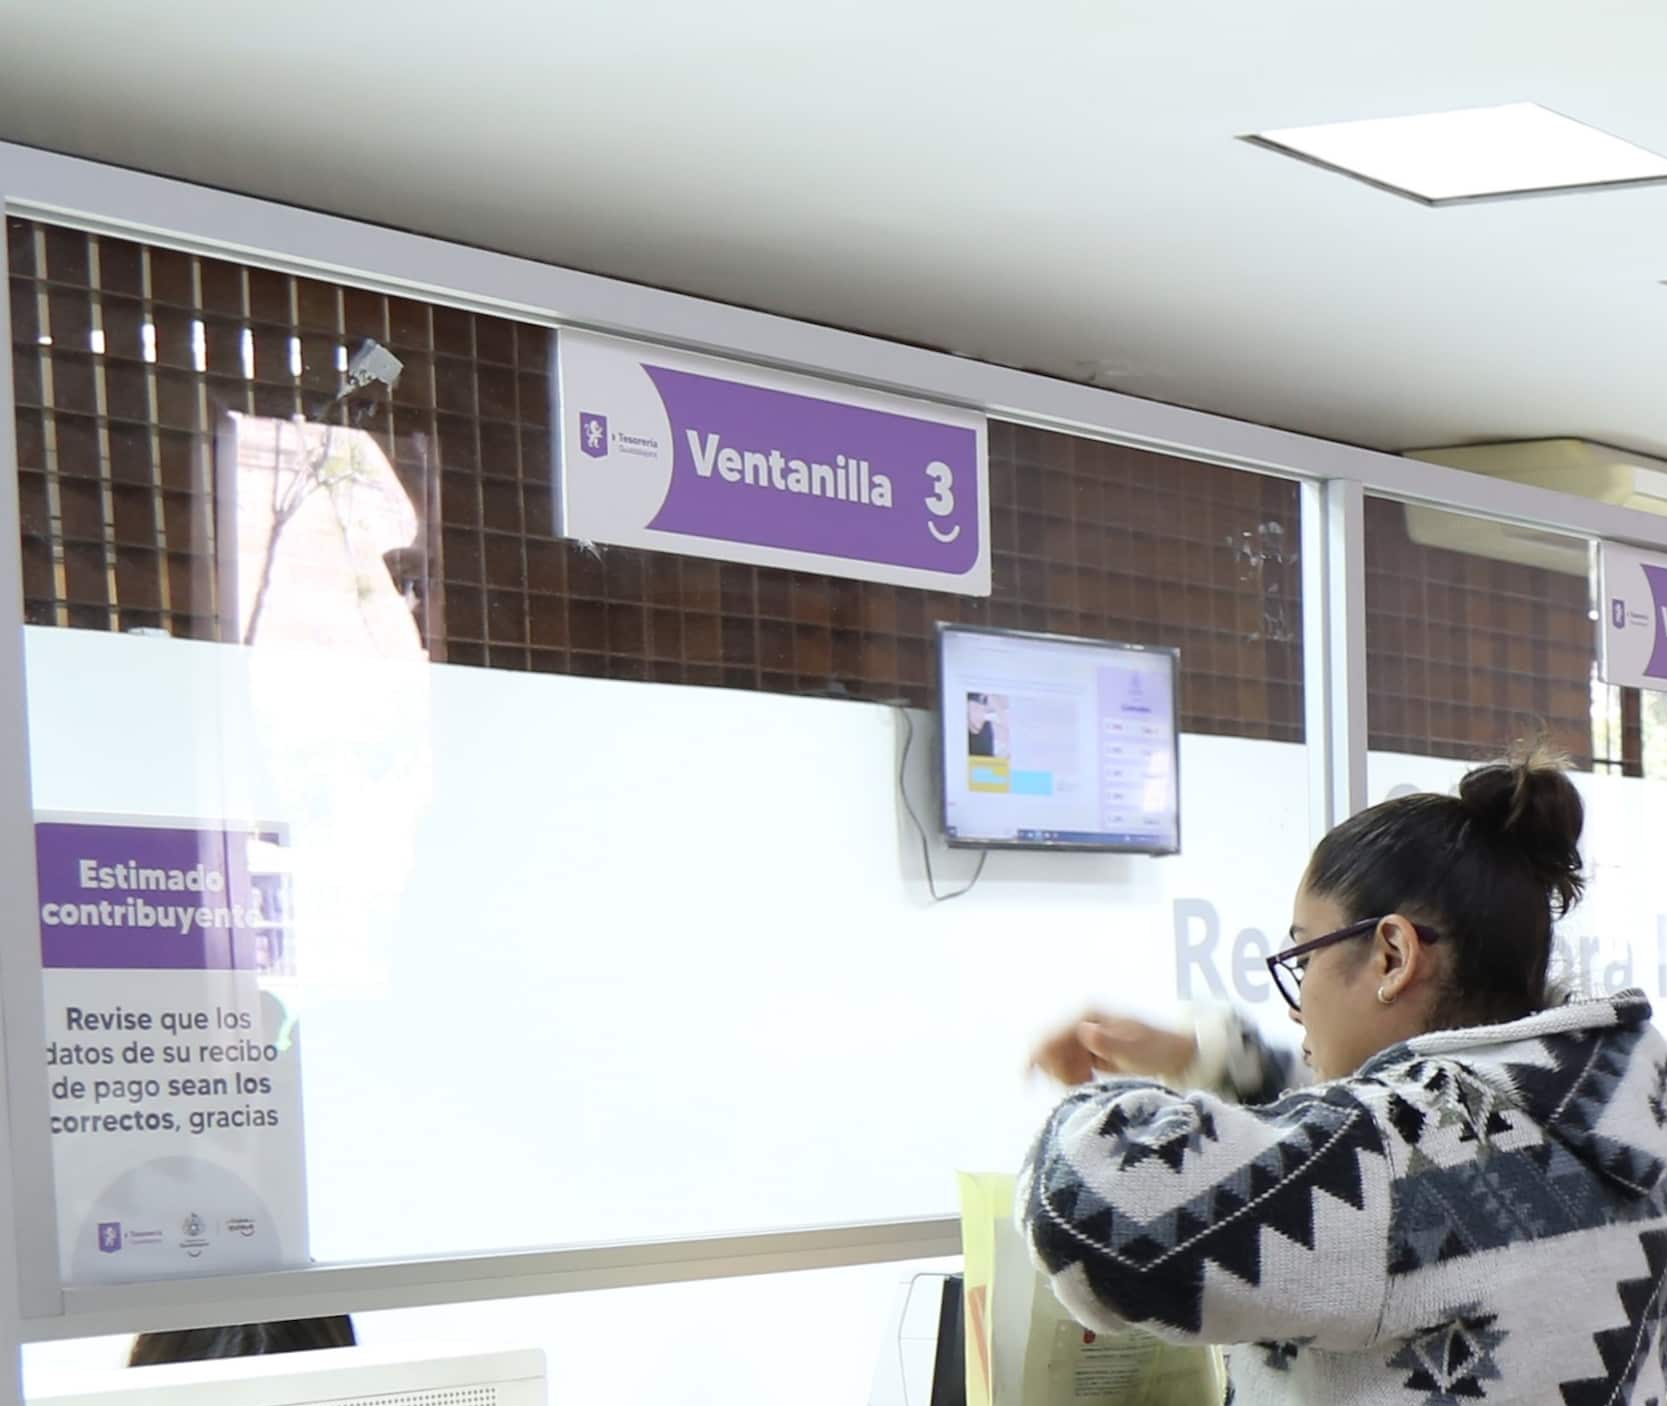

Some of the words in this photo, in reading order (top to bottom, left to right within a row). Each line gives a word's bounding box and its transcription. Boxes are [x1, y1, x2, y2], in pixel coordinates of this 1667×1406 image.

[686, 429, 893, 508] Ventanilla
[924, 460, 955, 517] 3
[79, 859, 225, 893] Estimado
[66, 1007, 152, 1031] Revise
[160, 1012, 209, 1035] que
[217, 1007, 252, 1030] los
[122, 1041, 155, 1064] de
[162, 1046, 191, 1063] su
[200, 1039, 278, 1063] recibo
[52, 1076, 85, 1100] de
[95, 1079, 160, 1104] pago
[168, 1077, 228, 1097] sean
[236, 1072, 271, 1095] los
[50, 1110, 182, 1134] correctos,
[189, 1104, 279, 1134] gracias
